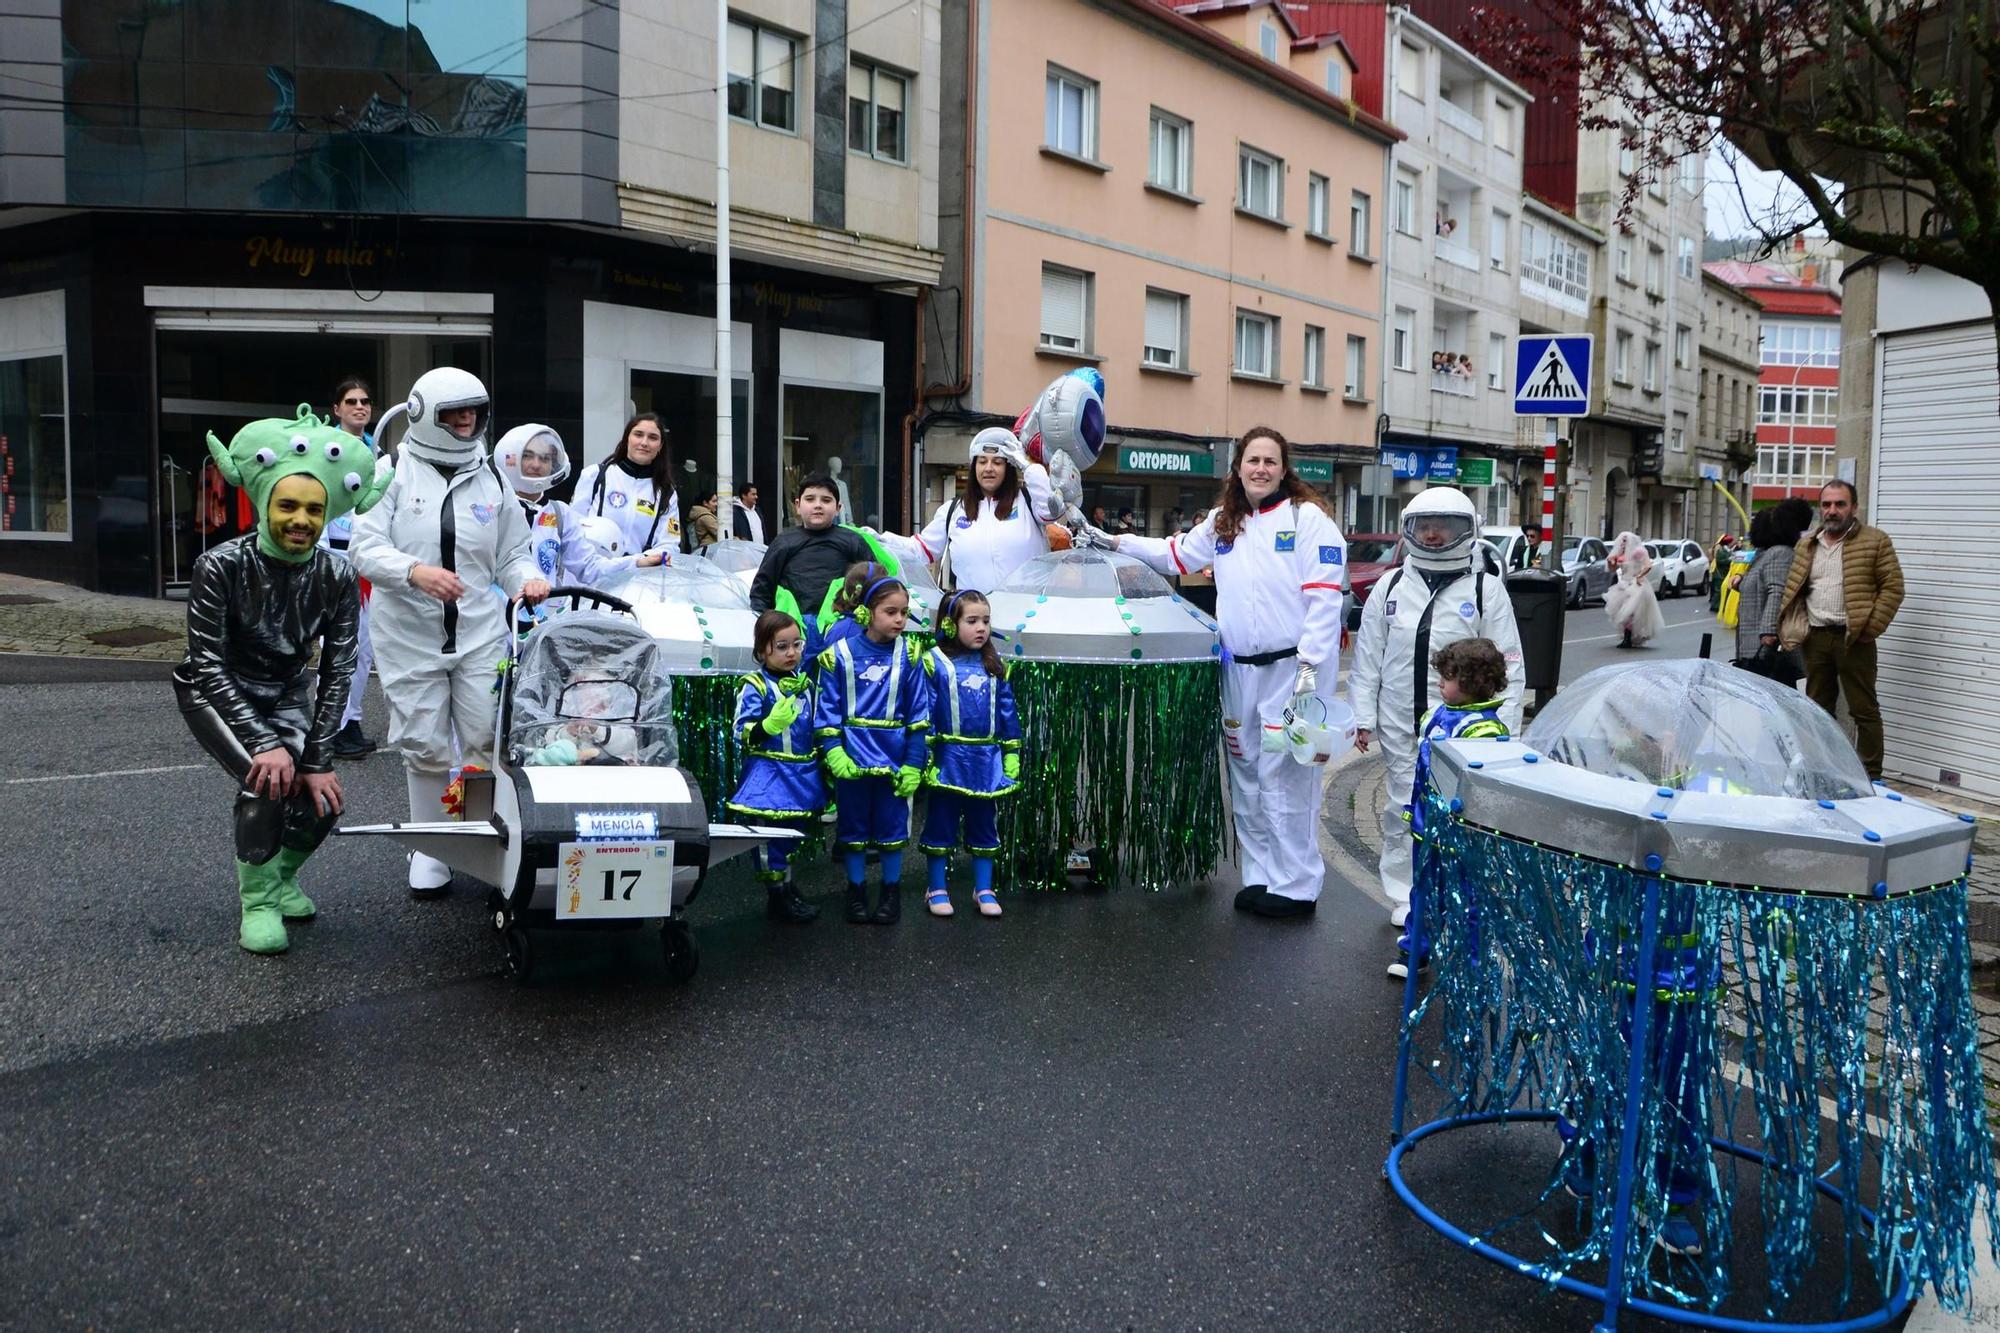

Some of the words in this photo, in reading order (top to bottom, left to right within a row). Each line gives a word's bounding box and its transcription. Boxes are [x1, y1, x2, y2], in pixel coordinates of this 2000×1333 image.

[245, 237, 315, 277] Muy
[752, 281, 791, 319] Muy
[1129, 451, 1191, 472] ORTOPEDIA
[1382, 452, 1407, 471] Allianz
[1430, 461, 1454, 469] Allianz
[600, 869, 641, 901] 17
